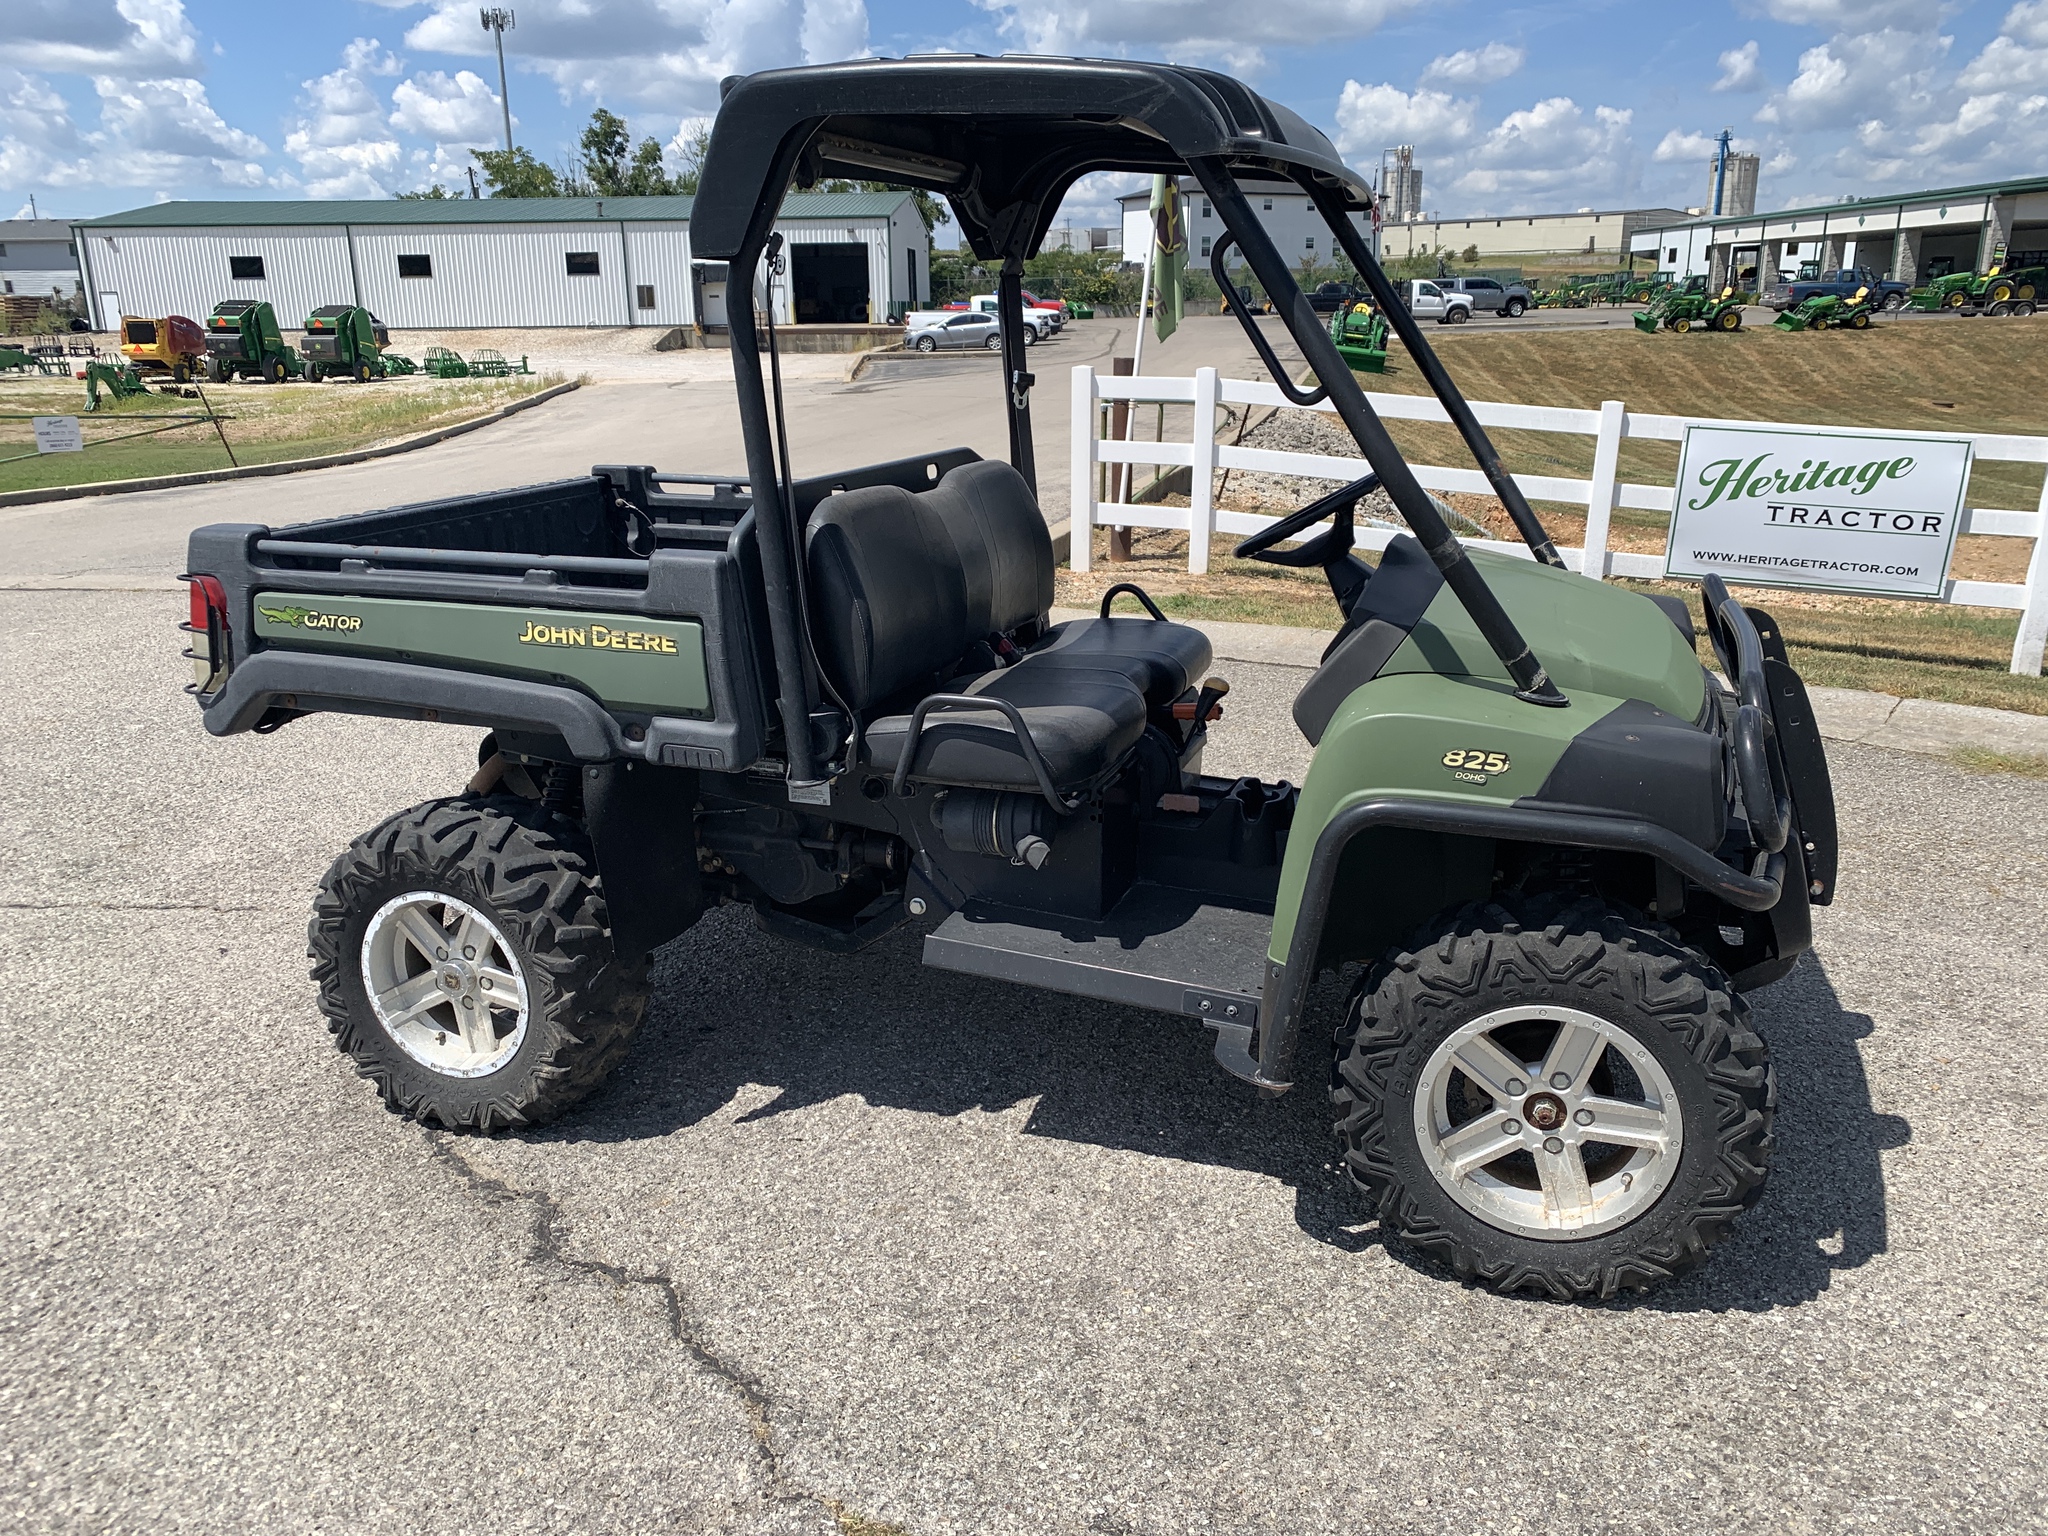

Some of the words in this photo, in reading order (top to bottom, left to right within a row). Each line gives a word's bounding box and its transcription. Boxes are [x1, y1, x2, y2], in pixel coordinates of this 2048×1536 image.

[1688, 452, 1918, 511] Heritage
[1767, 505, 1942, 533] TRACTOR
[1693, 550, 1919, 577] WWW.HERITAGETRACTOR.COM
[304, 611, 362, 631] GATOR
[519, 620, 586, 646] JOHN
[591, 624, 678, 653] DEERE
[1455, 771, 1486, 782] DOHC
